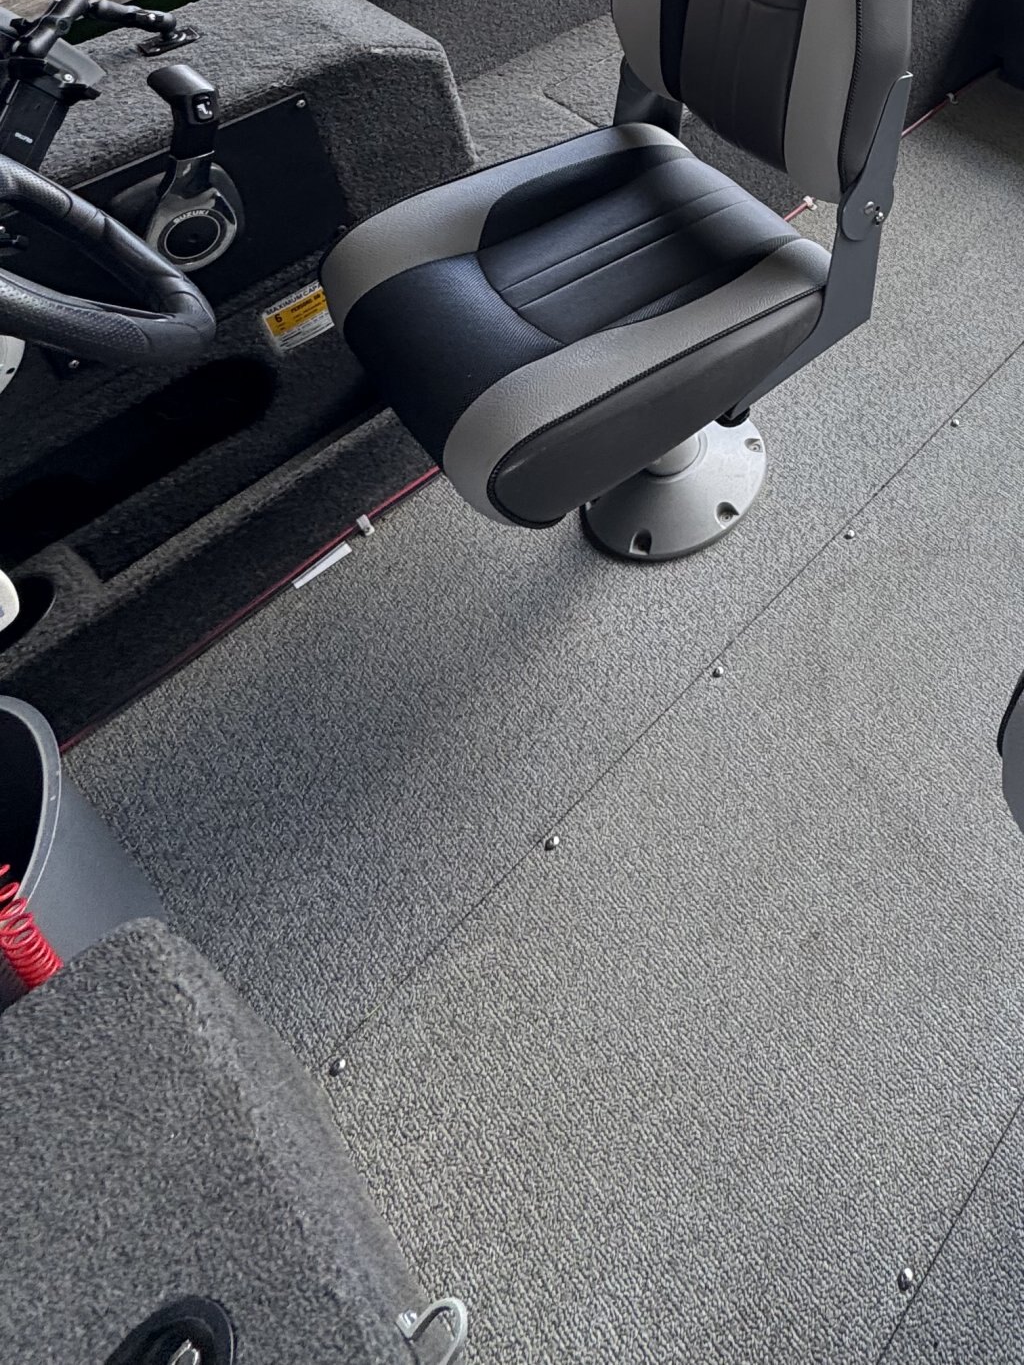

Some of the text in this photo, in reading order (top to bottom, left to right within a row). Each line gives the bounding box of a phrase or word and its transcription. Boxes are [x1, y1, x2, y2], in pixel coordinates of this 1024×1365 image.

[172, 209, 210, 224] SUZUKI
[265, 293, 304, 315] MAXIMUM
[274, 313, 283, 324] 6
